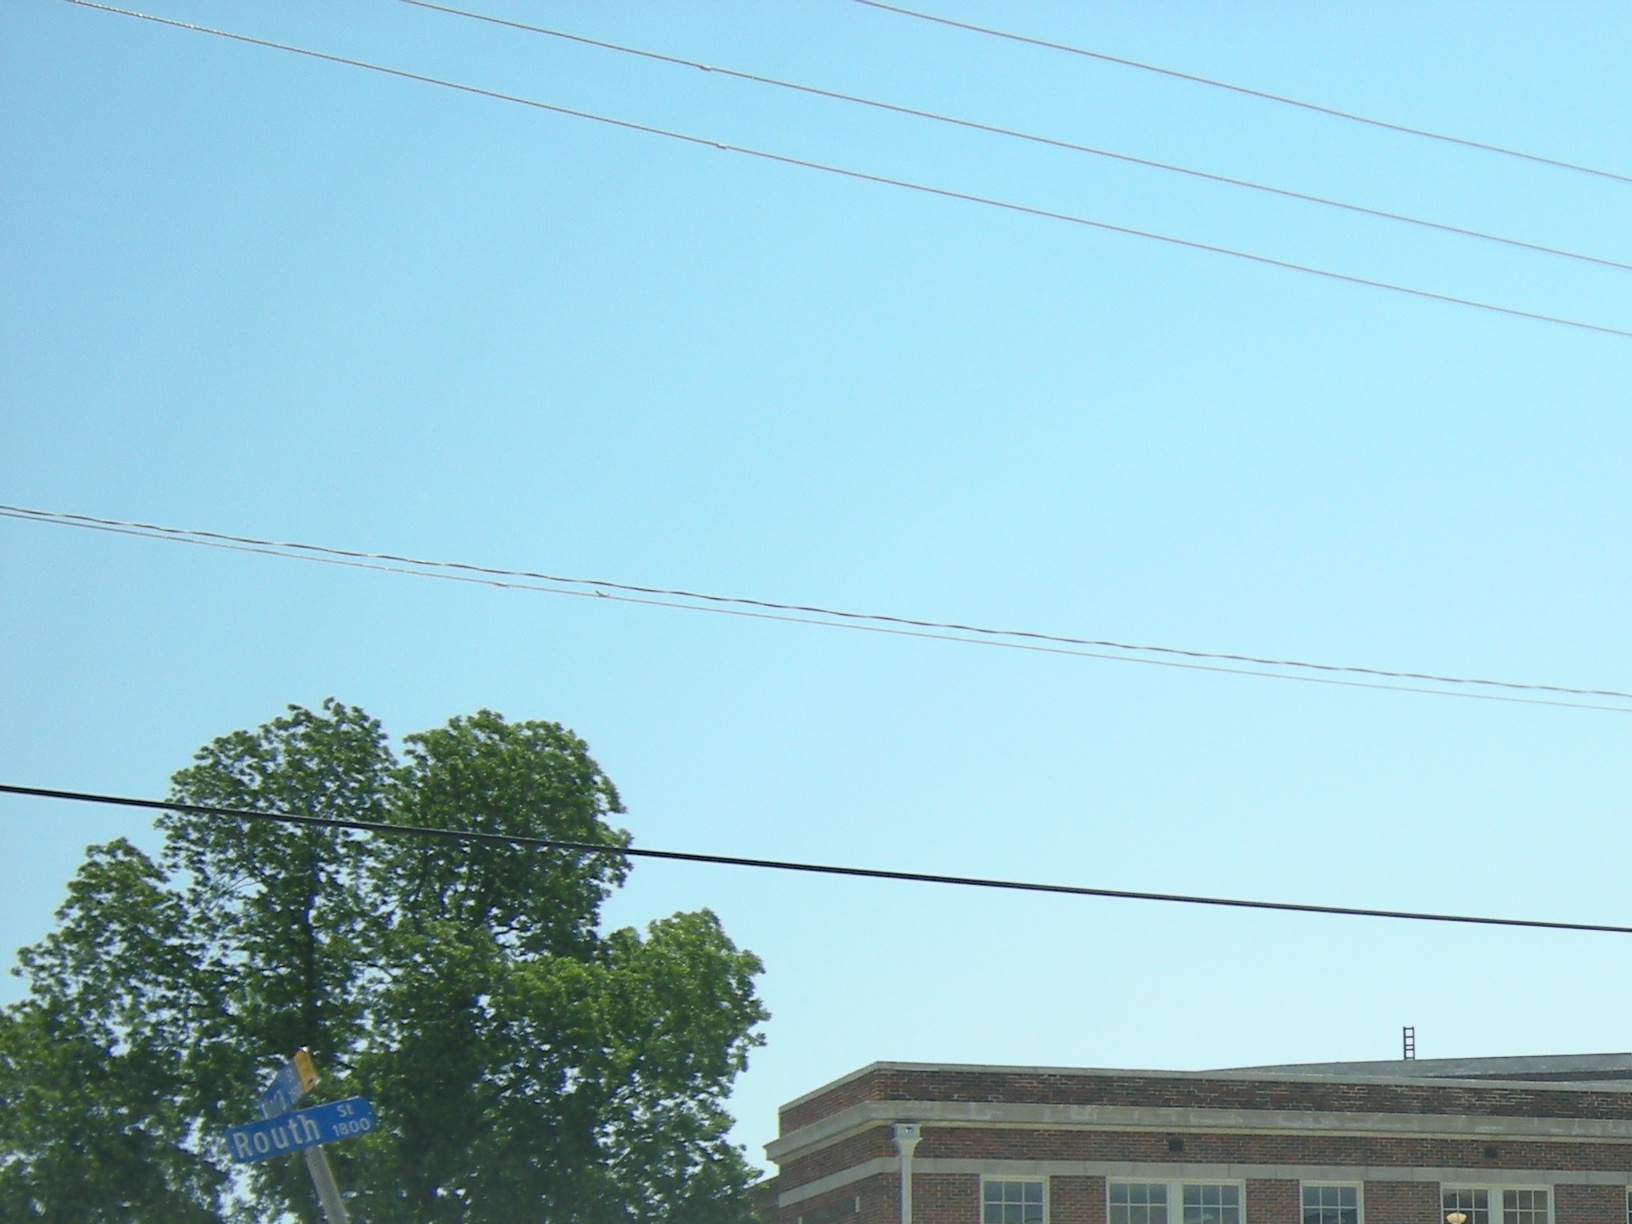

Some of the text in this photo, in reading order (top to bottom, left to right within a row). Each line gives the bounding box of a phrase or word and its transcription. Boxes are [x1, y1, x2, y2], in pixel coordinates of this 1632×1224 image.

[233, 1103, 354, 1158] Routh St
[332, 1117, 370, 1136] 1800
